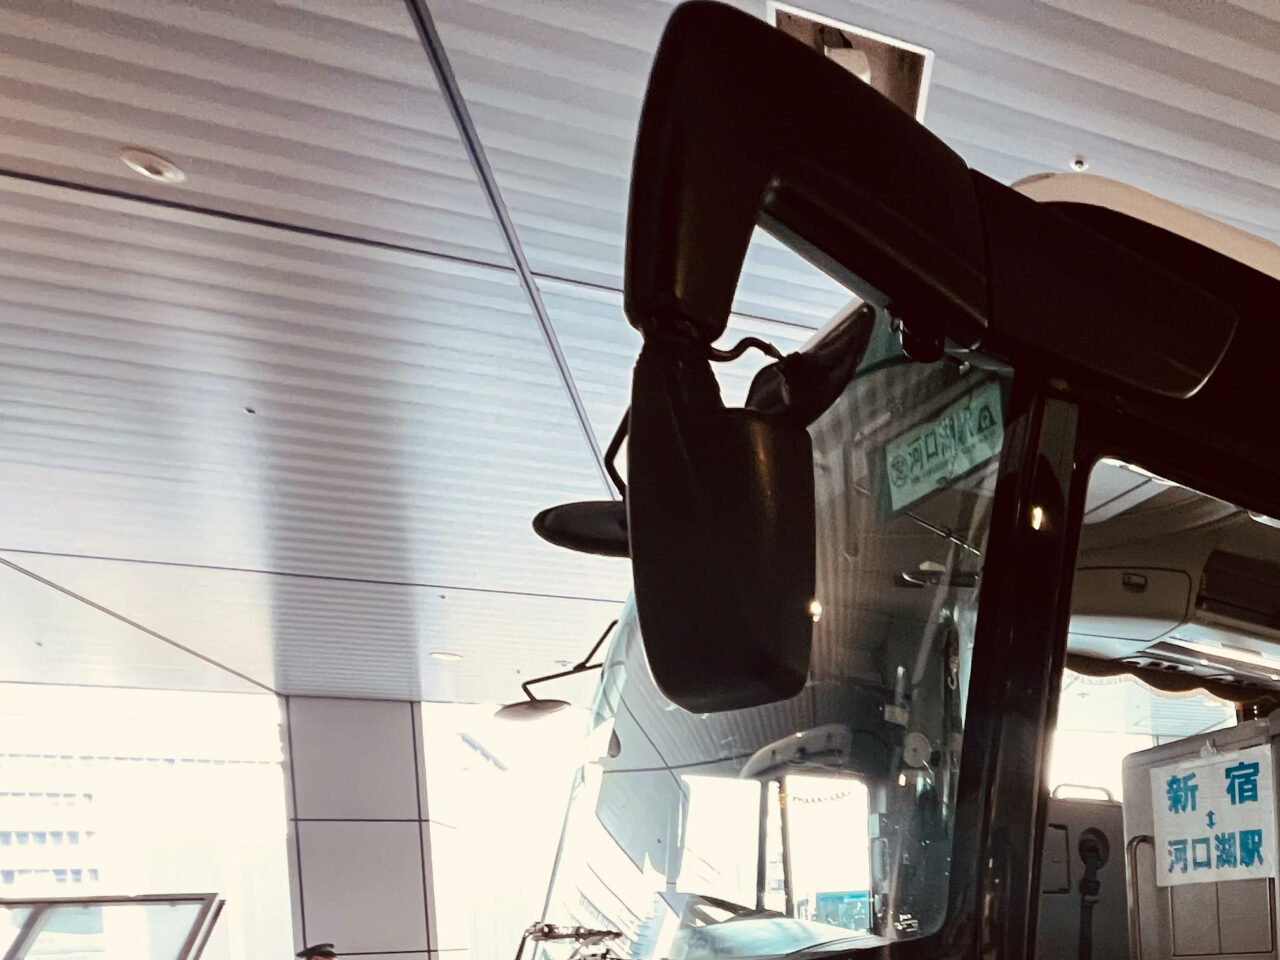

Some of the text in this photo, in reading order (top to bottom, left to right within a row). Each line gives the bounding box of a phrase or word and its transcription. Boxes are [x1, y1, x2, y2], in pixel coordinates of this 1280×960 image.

[1166, 761, 1260, 814] 新宿
[1168, 829, 1263, 874] 河口湖駅
